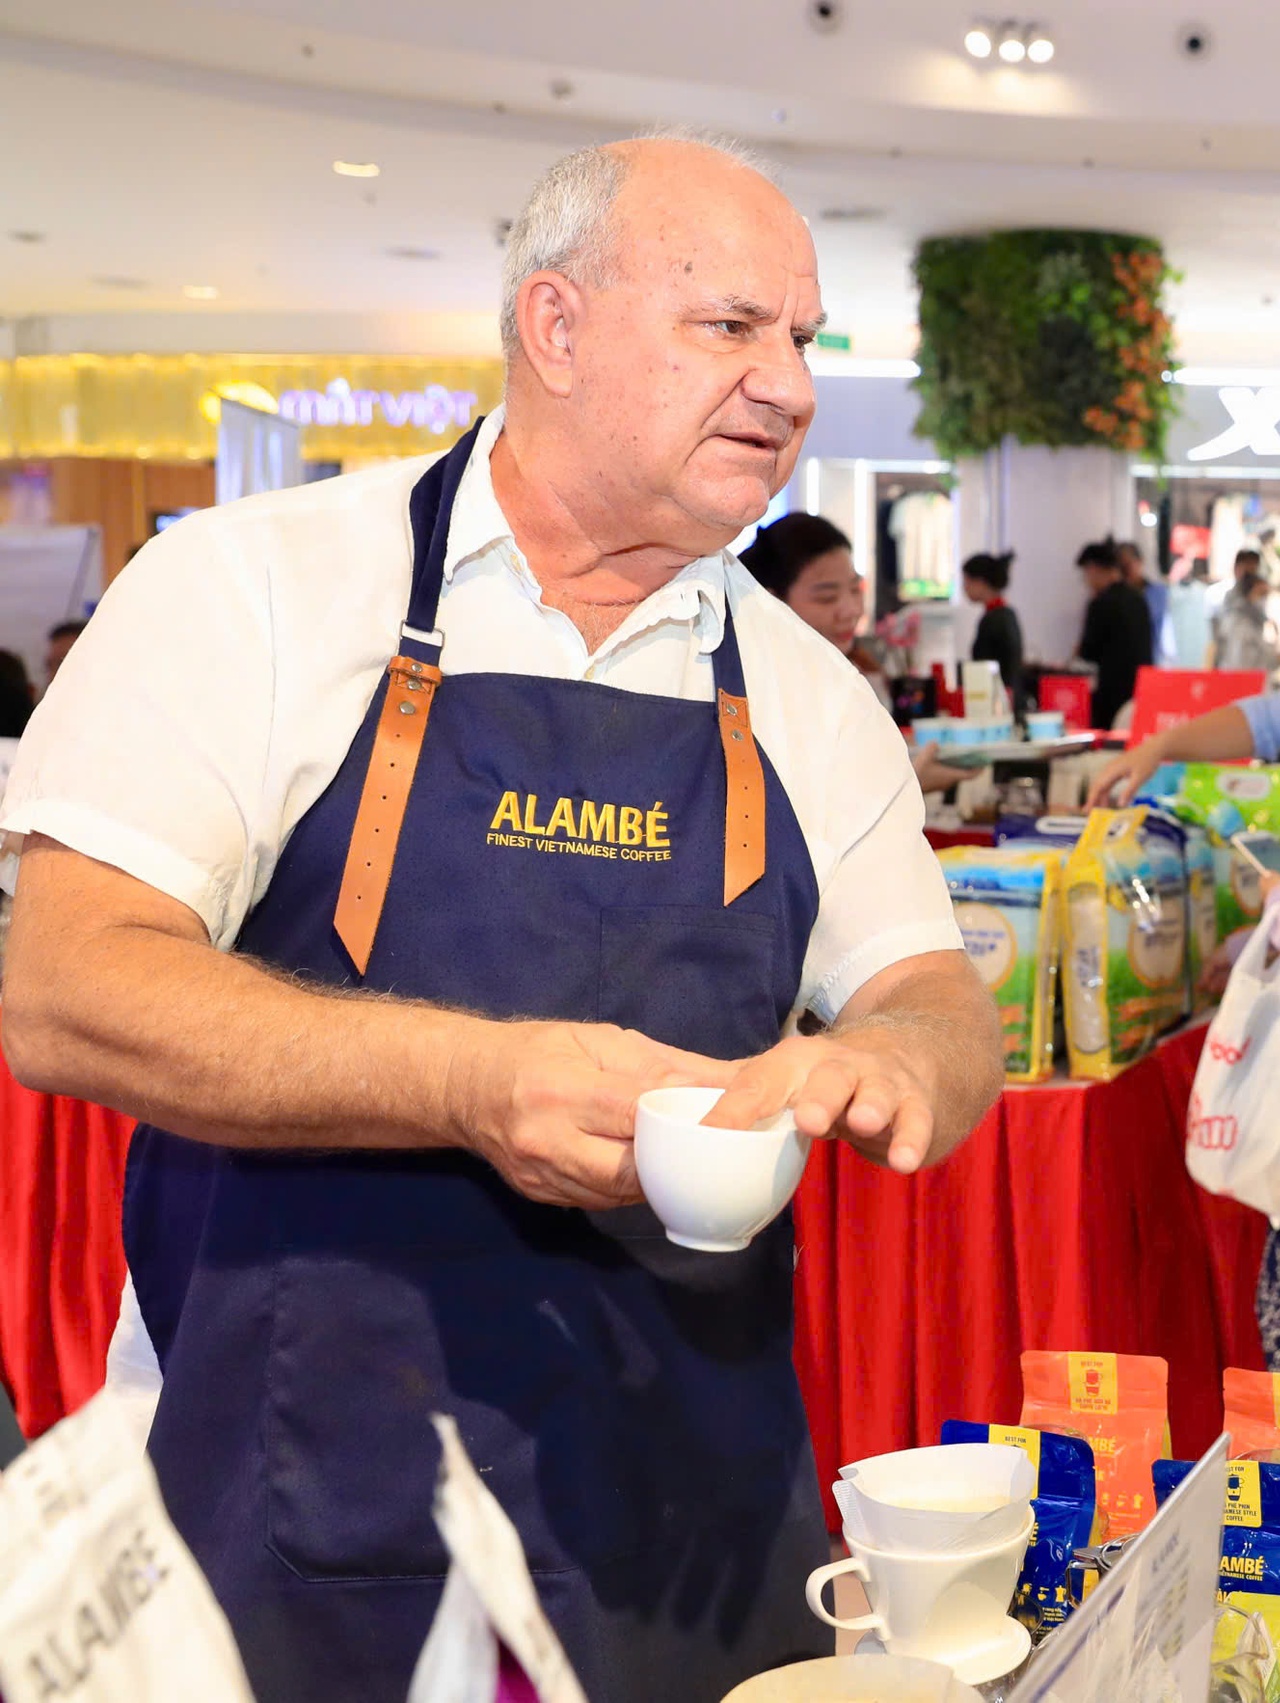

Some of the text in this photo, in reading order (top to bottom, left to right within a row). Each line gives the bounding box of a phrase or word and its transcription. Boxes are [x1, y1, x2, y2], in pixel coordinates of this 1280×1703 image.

[490, 791, 671, 848] ALAMBÉ
[487, 833, 671, 862] FINEST VIETNAMESE COFFEE
[1089, 1436, 1116, 1453] MBÉ
[1220, 1556, 1265, 1576] AMBÉ
